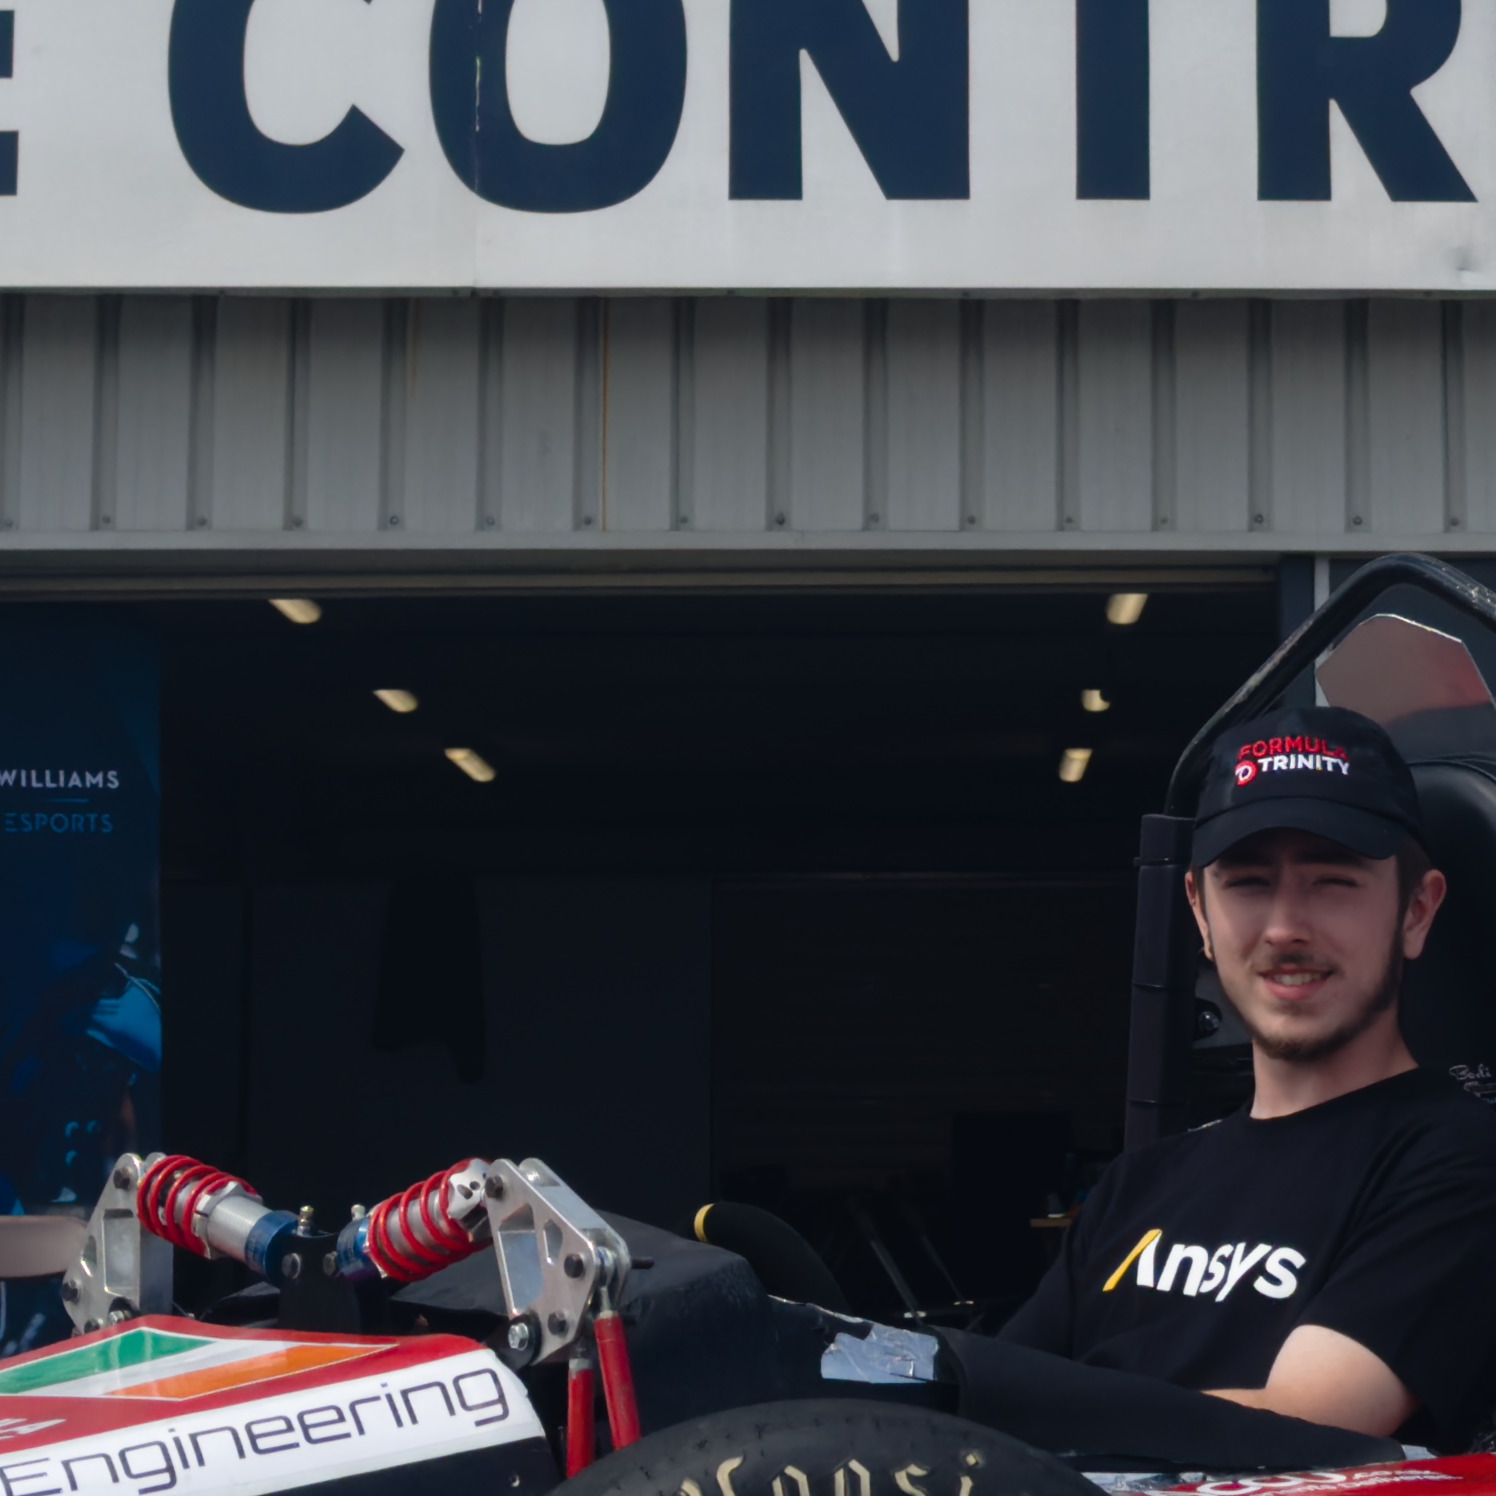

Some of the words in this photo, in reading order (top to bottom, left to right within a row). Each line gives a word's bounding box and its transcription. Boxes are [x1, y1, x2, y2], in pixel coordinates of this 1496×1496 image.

[1237, 735, 1349, 761] FORMULA
[1257, 753, 1351, 776] TRINITY
[4, 811, 114, 835] ESPORTS
